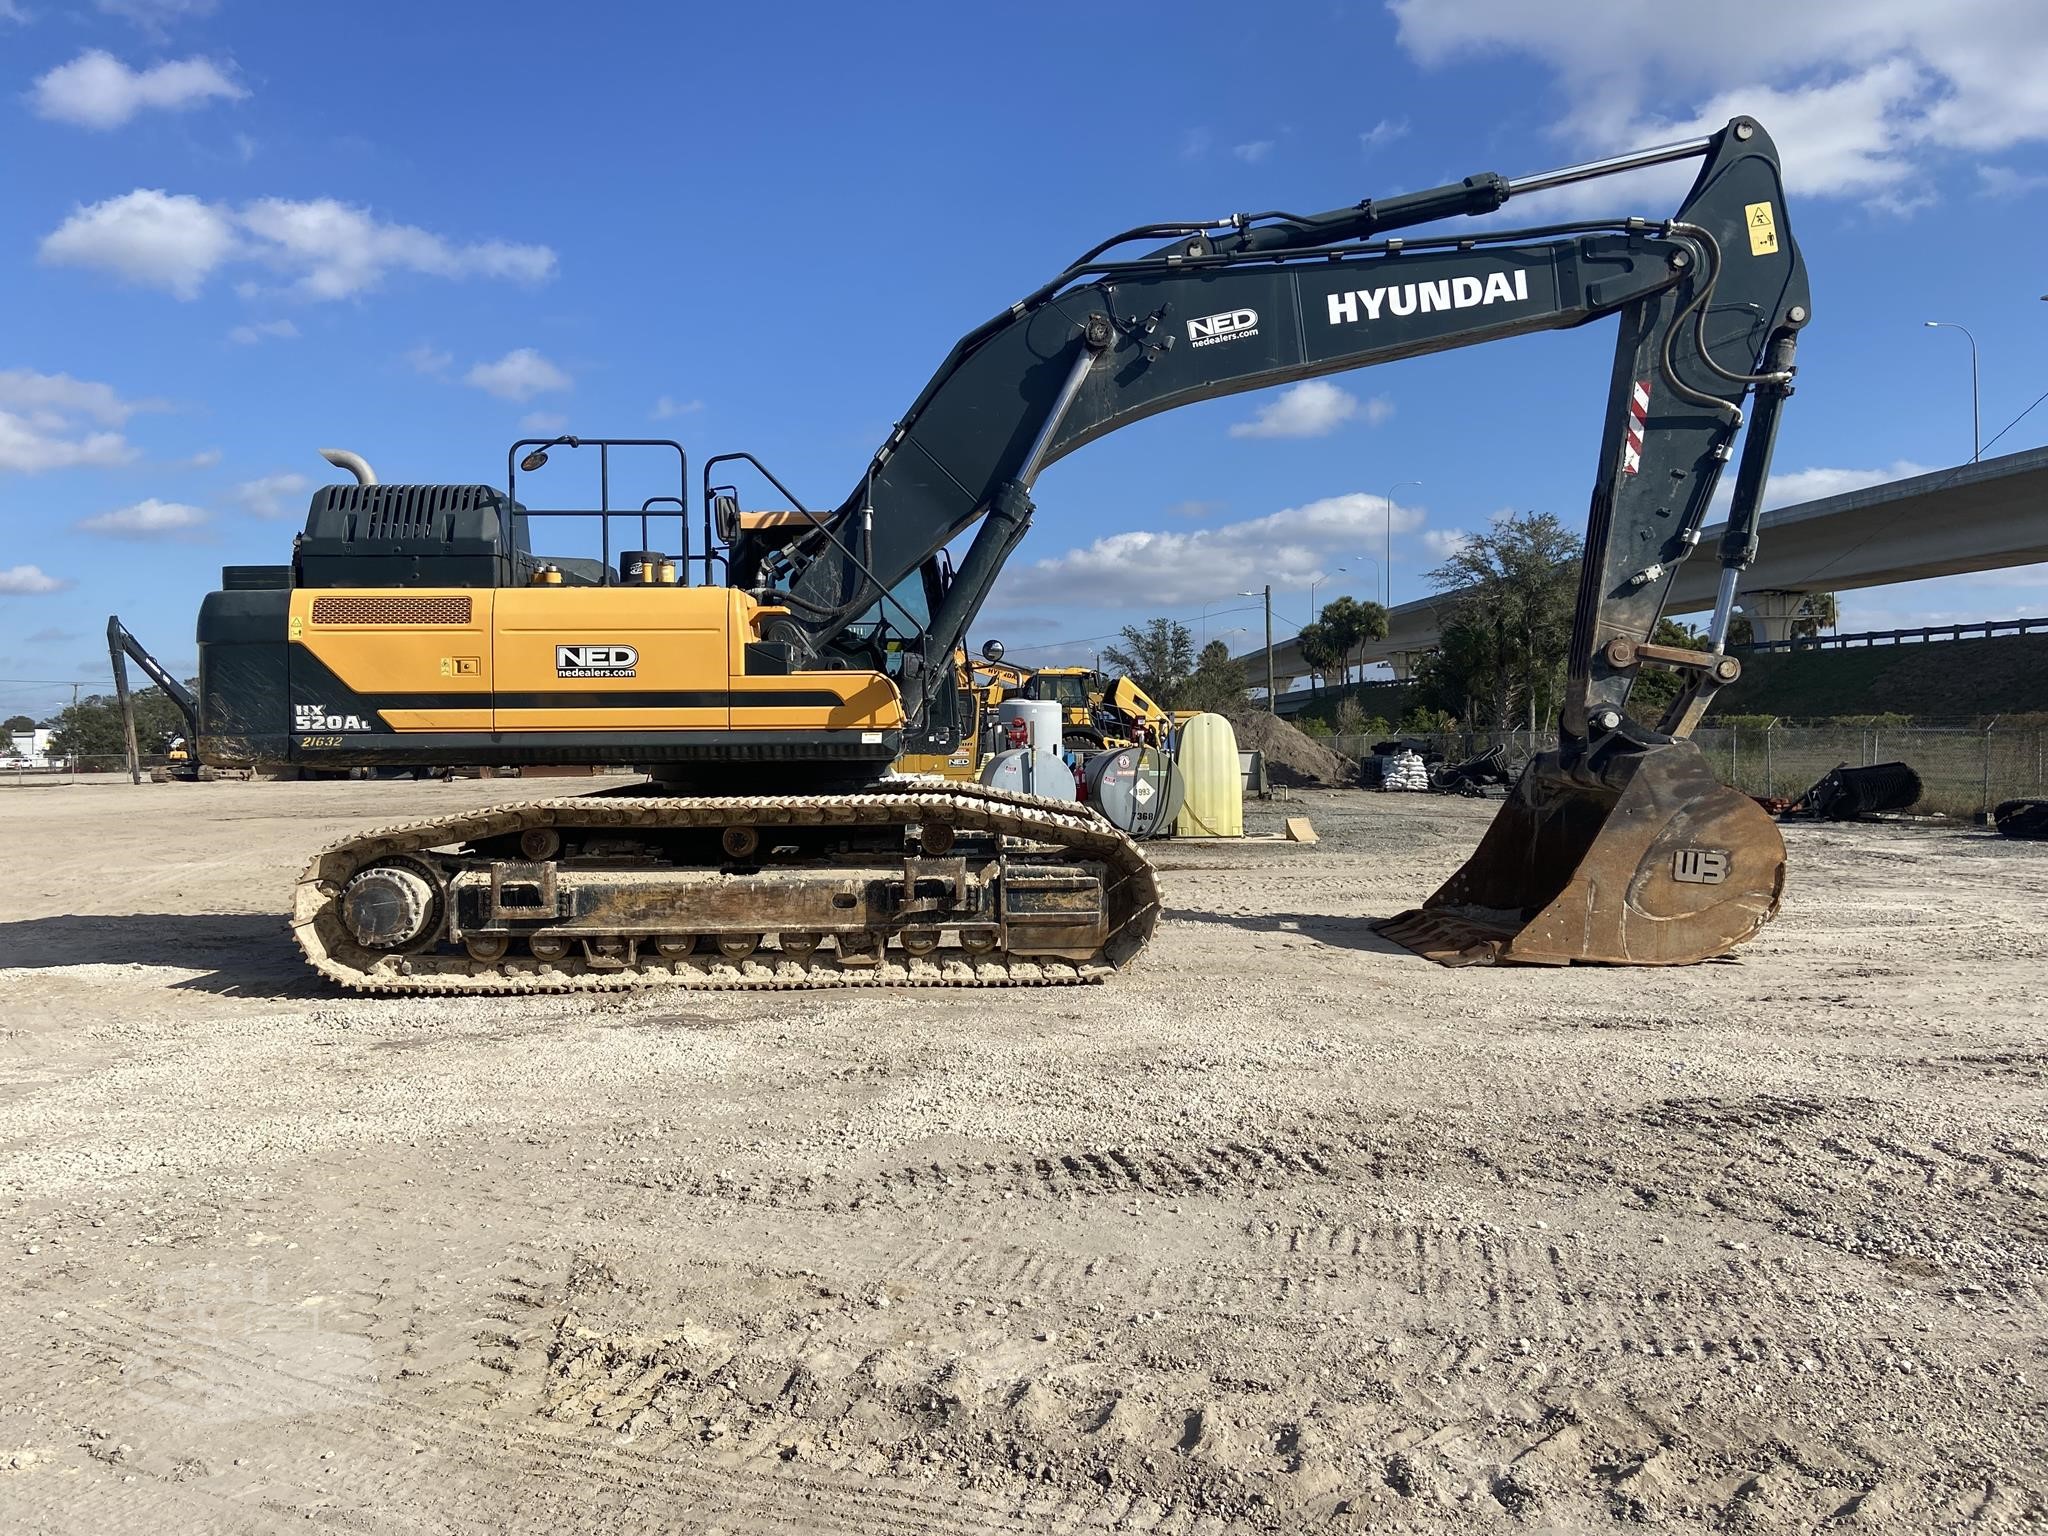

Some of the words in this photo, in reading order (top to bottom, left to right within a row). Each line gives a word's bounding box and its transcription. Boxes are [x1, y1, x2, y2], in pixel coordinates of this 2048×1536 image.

[1327, 269, 1529, 325] HYUNDAI
[1188, 309, 1257, 340] NED
[1192, 328, 1259, 348] nedealers.com
[558, 647, 637, 667] NED
[558, 668, 635, 677] nedealers.com
[295, 714, 371, 731] 520AL
[300, 736, 343, 748] 21632
[1132, 812, 1154, 821] 7368
